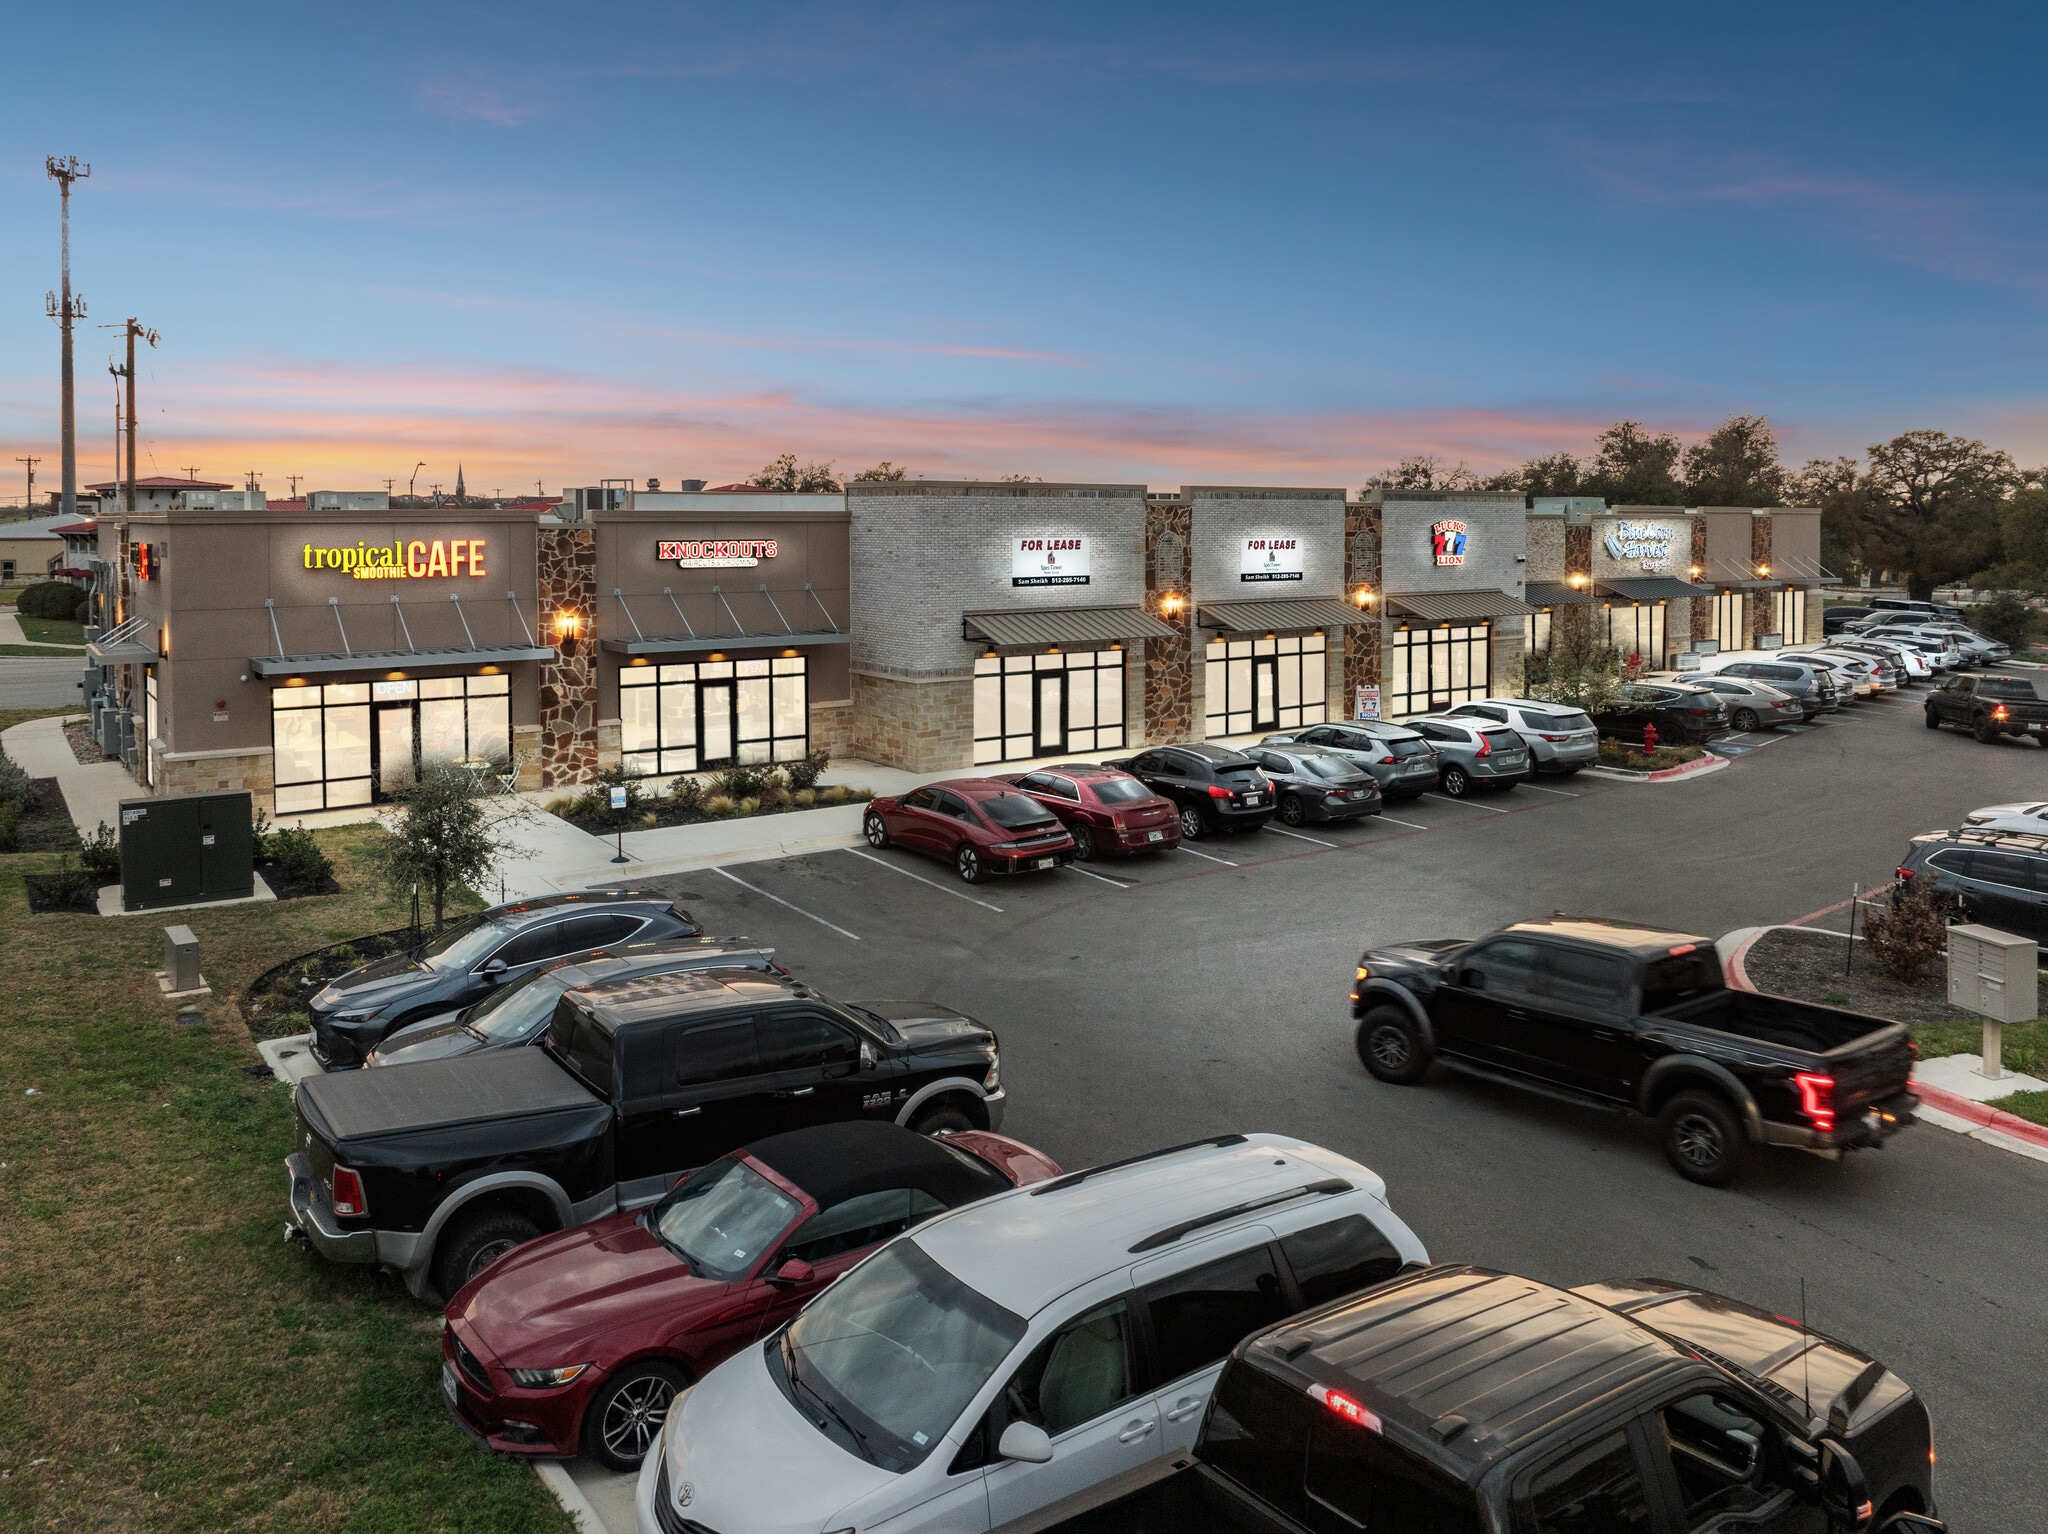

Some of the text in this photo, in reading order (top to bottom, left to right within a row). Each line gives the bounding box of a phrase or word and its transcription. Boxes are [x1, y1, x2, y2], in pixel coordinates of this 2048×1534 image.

[1434, 521, 1467, 535] LUCKY
[1619, 521, 1674, 540] Blue Corn
[659, 541, 777, 559] KNOCKOUTS
[1021, 539, 1081, 551] FOR LEASE
[1248, 540, 1296, 550] FOR LEASE
[1434, 532, 1467, 556] 777
[1624, 541, 1668, 558] Harvest
[303, 539, 486, 578] tropical CAFE
[682, 559, 715, 567] HAIRCUTS
[722, 558, 756, 566] GROOMING
[1438, 556, 1463, 565] LION
[353, 566, 407, 579] SMOOTHIE
[376, 681, 413, 694] OPEN
